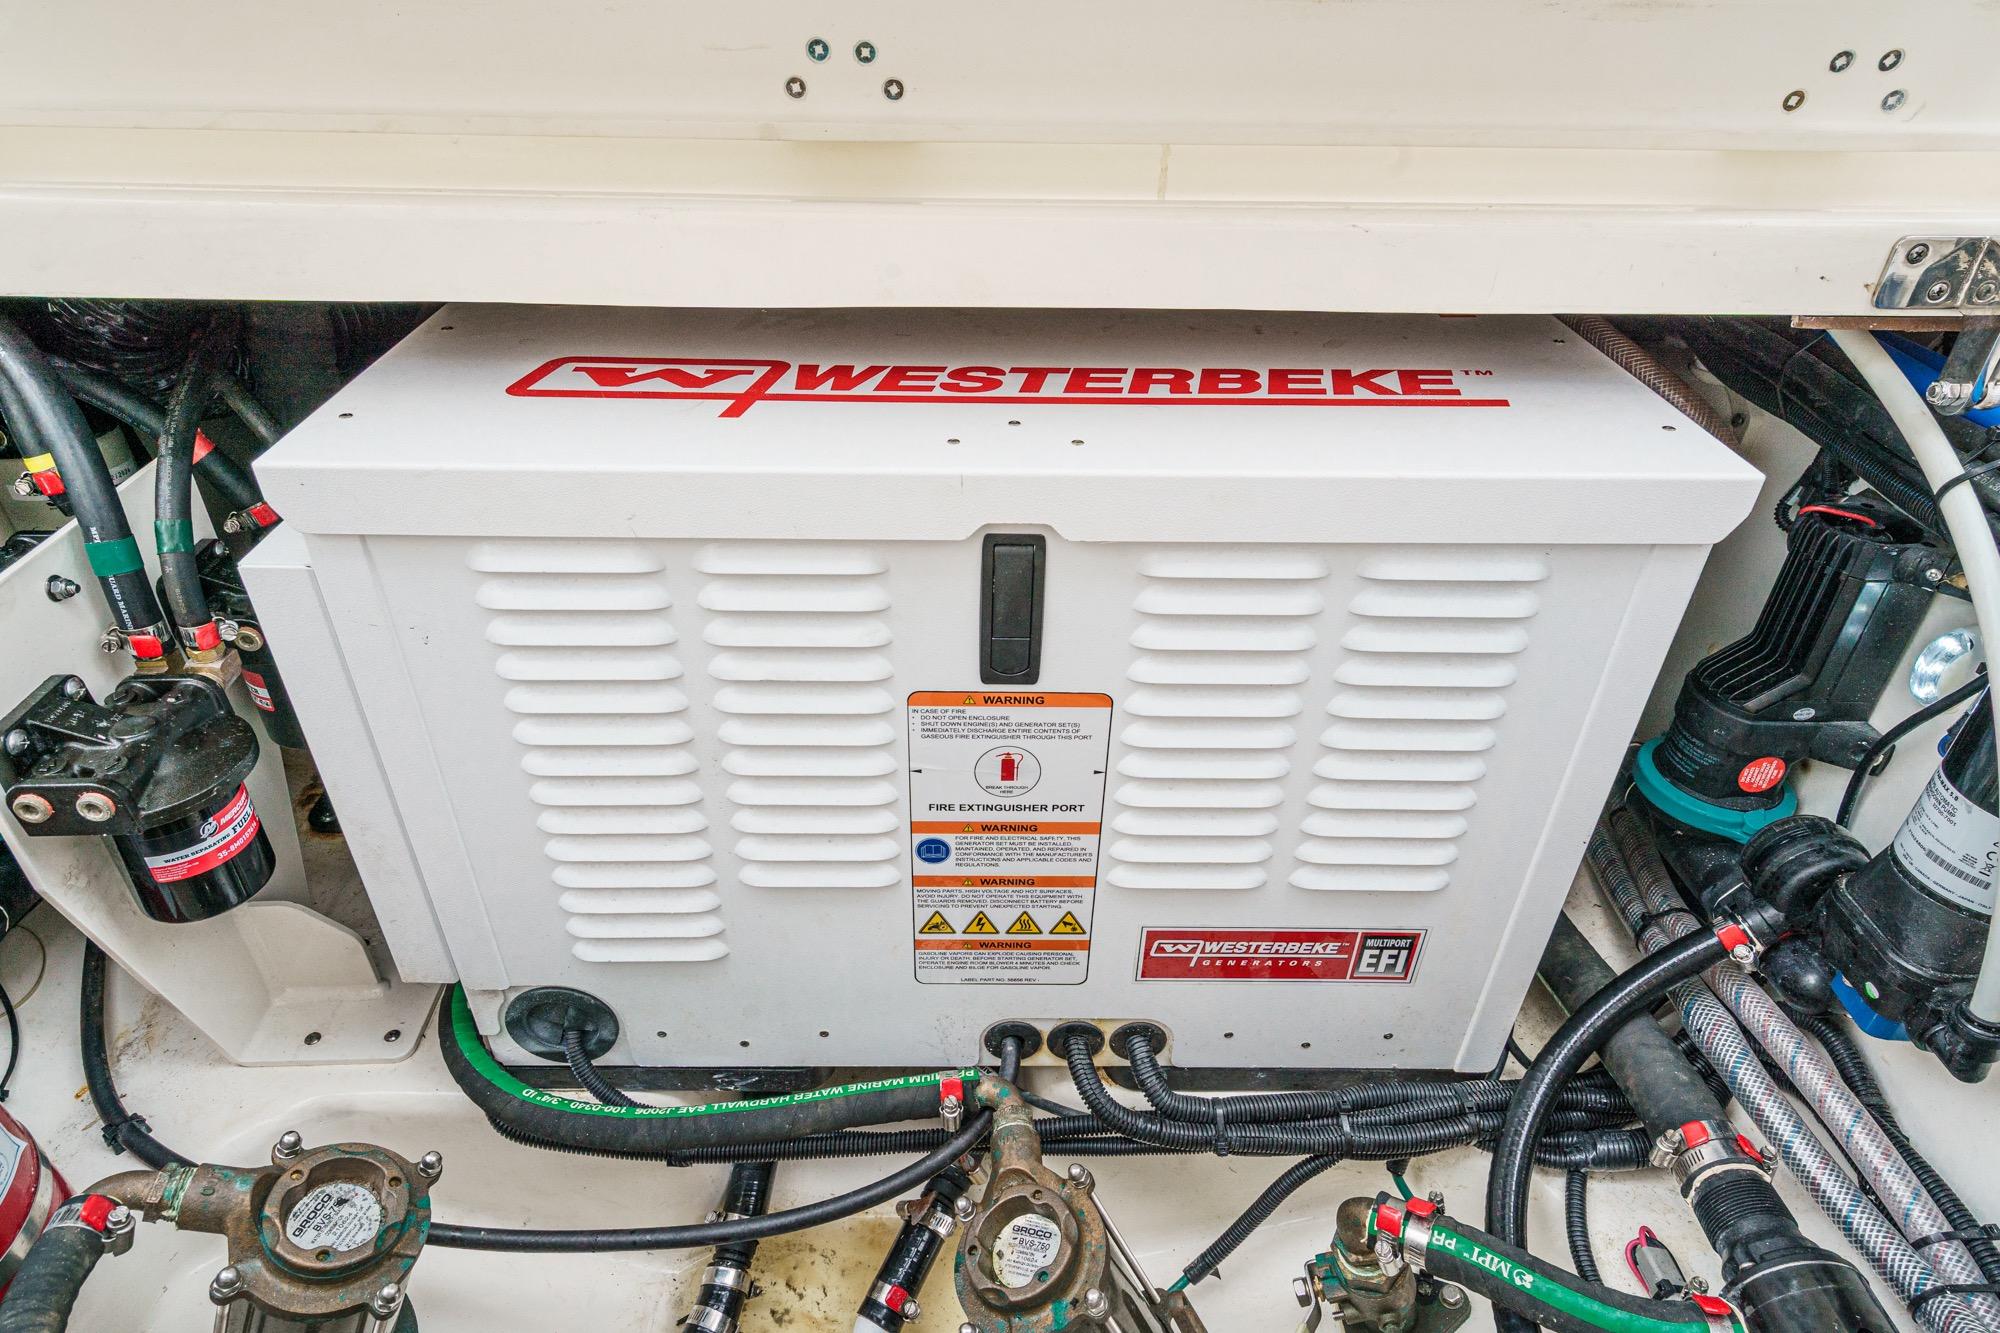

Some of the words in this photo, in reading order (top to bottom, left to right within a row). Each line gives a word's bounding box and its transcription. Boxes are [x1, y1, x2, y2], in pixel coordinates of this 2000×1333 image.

[794, 364, 1462, 396] WESTERBEKE
[983, 696, 1045, 704] WARNING
[1935, 787, 1959, 814] AUTOMATIC
[928, 803, 956, 812] FIRE
[959, 804, 1048, 812] EXTINGUISHER
[1052, 804, 1086, 812] PORT
[1941, 804, 1956, 818] PUMP
[164, 854, 190, 864] WATER
[190, 833, 230, 856] SEPARATING
[231, 811, 251, 834] FUEL
[1932, 880, 1956, 895] GERMANY
[1204, 942, 1340, 954] WESTERBEKE
[1366, 939, 1411, 947] MULTIPORT
[1359, 950, 1407, 973] EFI
[522, 1088, 535, 1097] ID
[794, 1087, 843, 1099] WATER
[571, 1100, 627, 1113] 100-0340
[711, 1093, 791, 1110] HARDWALL
[635, 1106, 675, 1115] J2006
[677, 1104, 706, 1113] SAE
[292, 1194, 332, 1237] GROCO
[1013, 1225, 1052, 1238] GROCO
[1019, 1238, 1050, 1251] BVS-750
[1471, 1246, 1511, 1279] MPI
